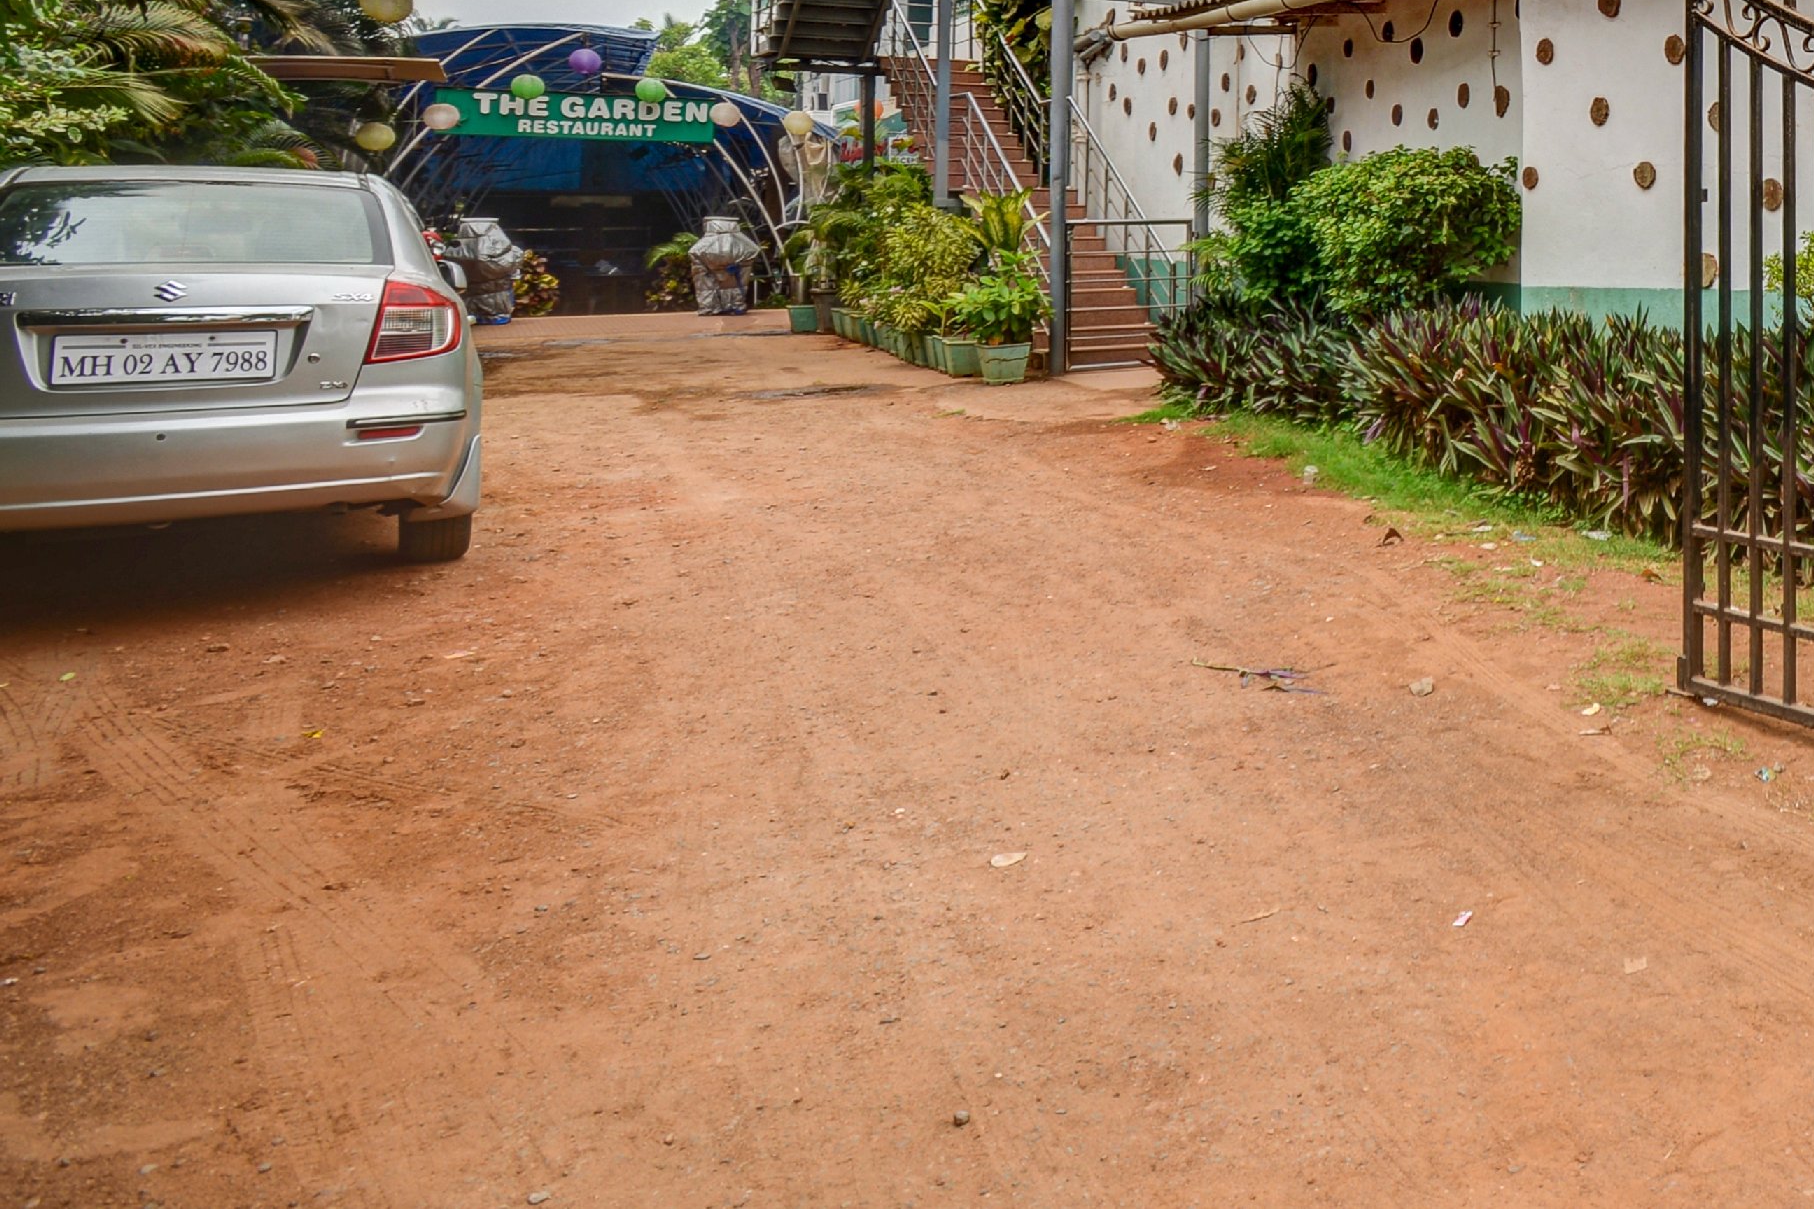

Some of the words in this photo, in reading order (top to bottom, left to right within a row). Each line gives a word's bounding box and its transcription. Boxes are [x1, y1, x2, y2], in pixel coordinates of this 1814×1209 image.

[473, 92, 549, 116] THE
[560, 96, 709, 123] GARDEN
[517, 119, 656, 137] RESTAURANT
[59, 355, 114, 378] MH
[123, 351, 153, 375] 02
[159, 352, 203, 374] AY
[211, 350, 267, 372] 7988
